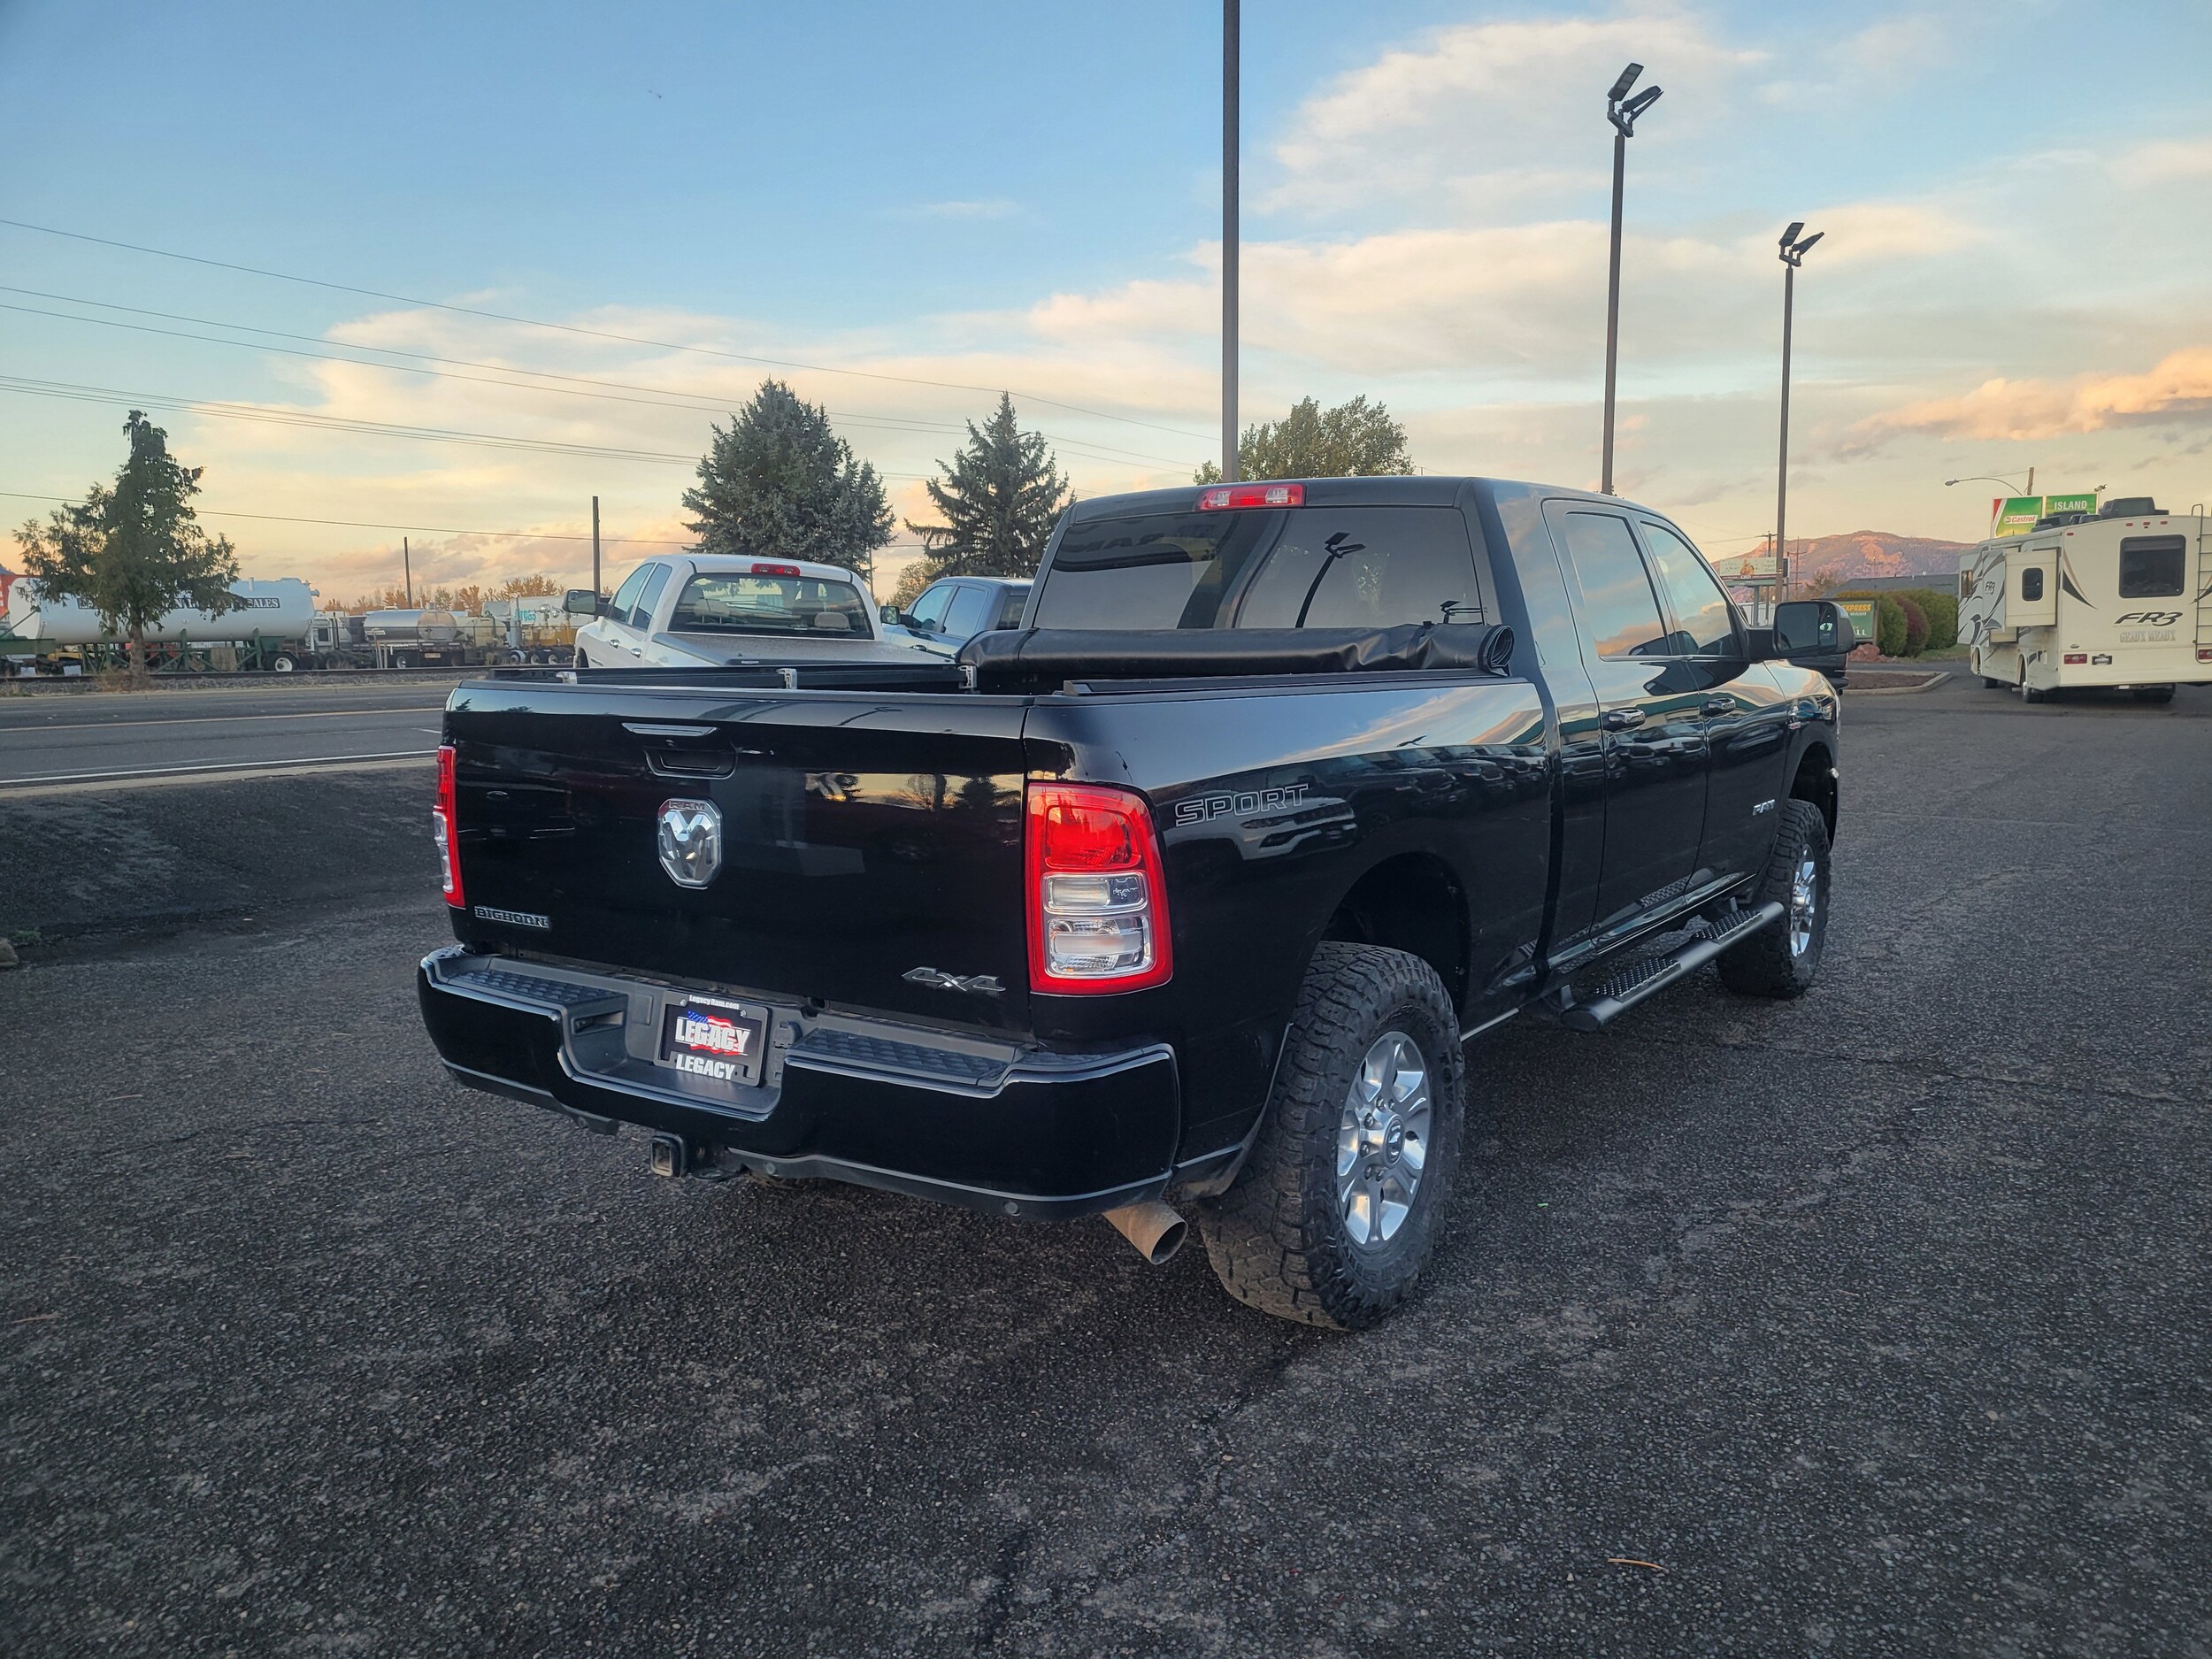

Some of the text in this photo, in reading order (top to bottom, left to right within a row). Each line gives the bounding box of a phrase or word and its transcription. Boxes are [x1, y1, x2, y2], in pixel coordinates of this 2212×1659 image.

[2054, 500, 2087, 511] ISLAND
[247, 598, 280, 609] SALES
[2114, 611, 2184, 627] FR3
[668, 801, 706, 811] RAM
[1175, 783, 1309, 827] SPORT
[474, 906, 549, 928] BIGHORN
[675, 1018, 750, 1053] LEGACY
[675, 1054, 735, 1079] LEGACY
